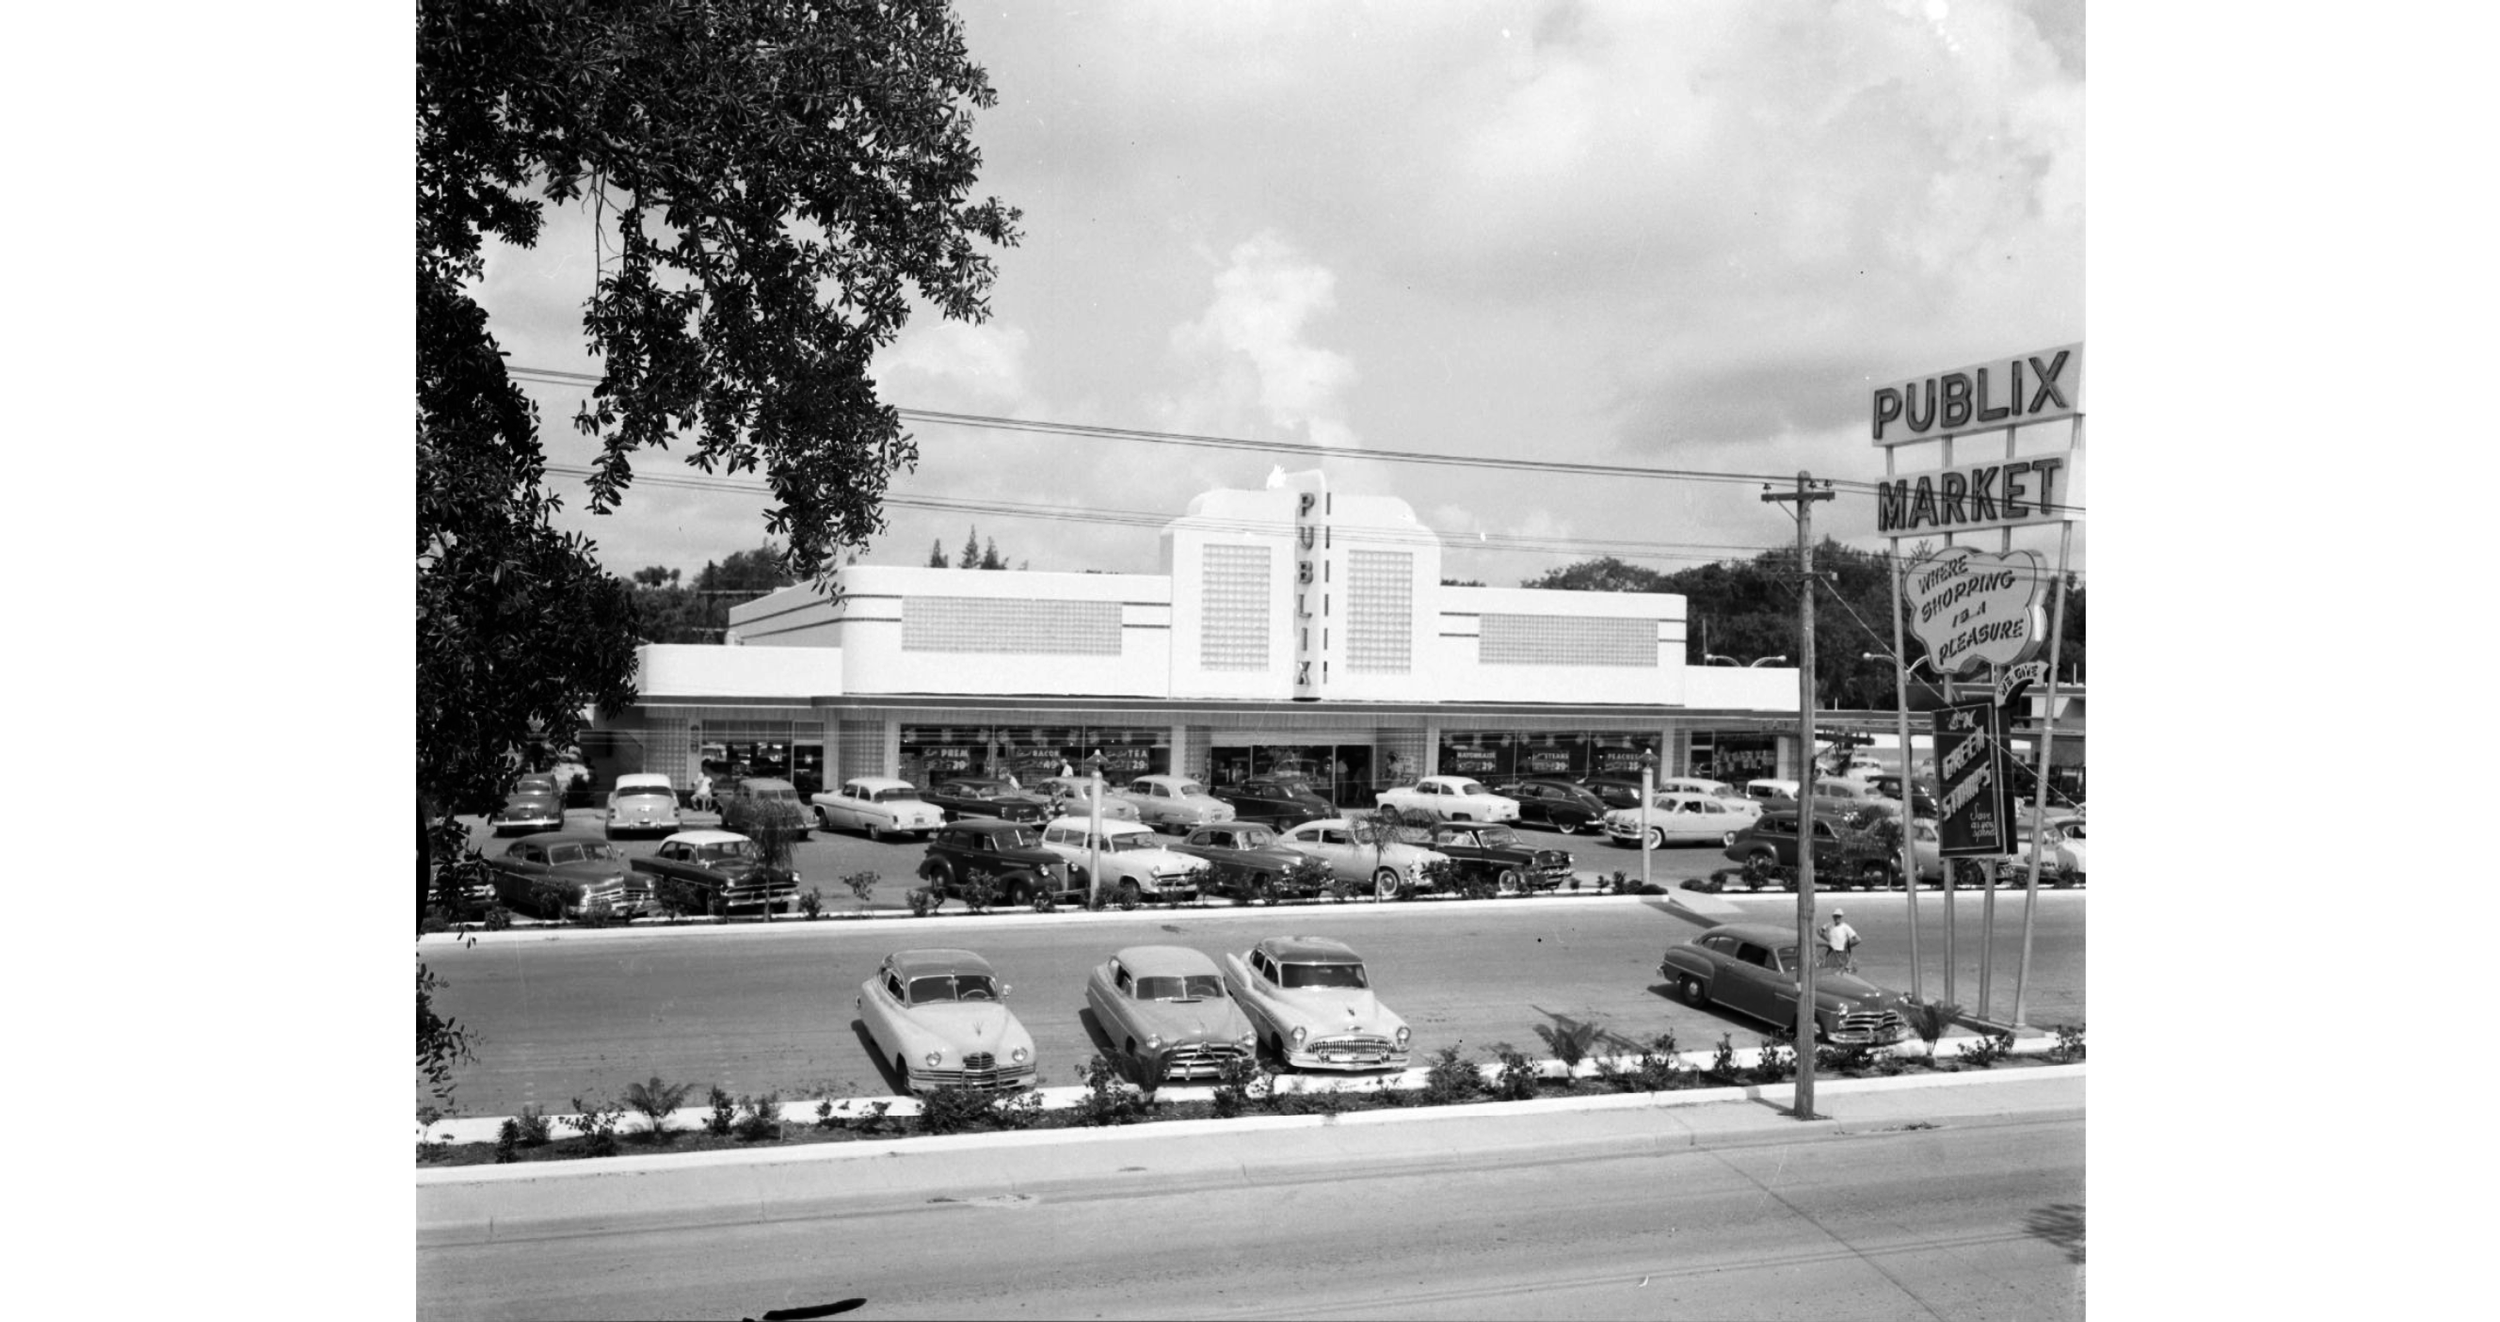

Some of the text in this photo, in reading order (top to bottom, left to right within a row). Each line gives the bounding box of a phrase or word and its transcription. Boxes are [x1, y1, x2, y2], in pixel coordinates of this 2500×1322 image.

[1873, 350, 2070, 439] PUBLIX
[1878, 457, 2063, 531] MARKET
[1296, 492, 1315, 685] PUBLIX
[1918, 554, 1969, 594] WHERE
[1921, 569, 2016, 623] SHOPPING
[1939, 618, 2024, 666] PLEASURE
[2014, 664, 2038, 679] GIVE
[1128, 749, 1148, 758] TEA
[1942, 725, 1985, 780] GREEN
[1942, 761, 1991, 821] STAMPS
[1970, 802, 1992, 820] Save
